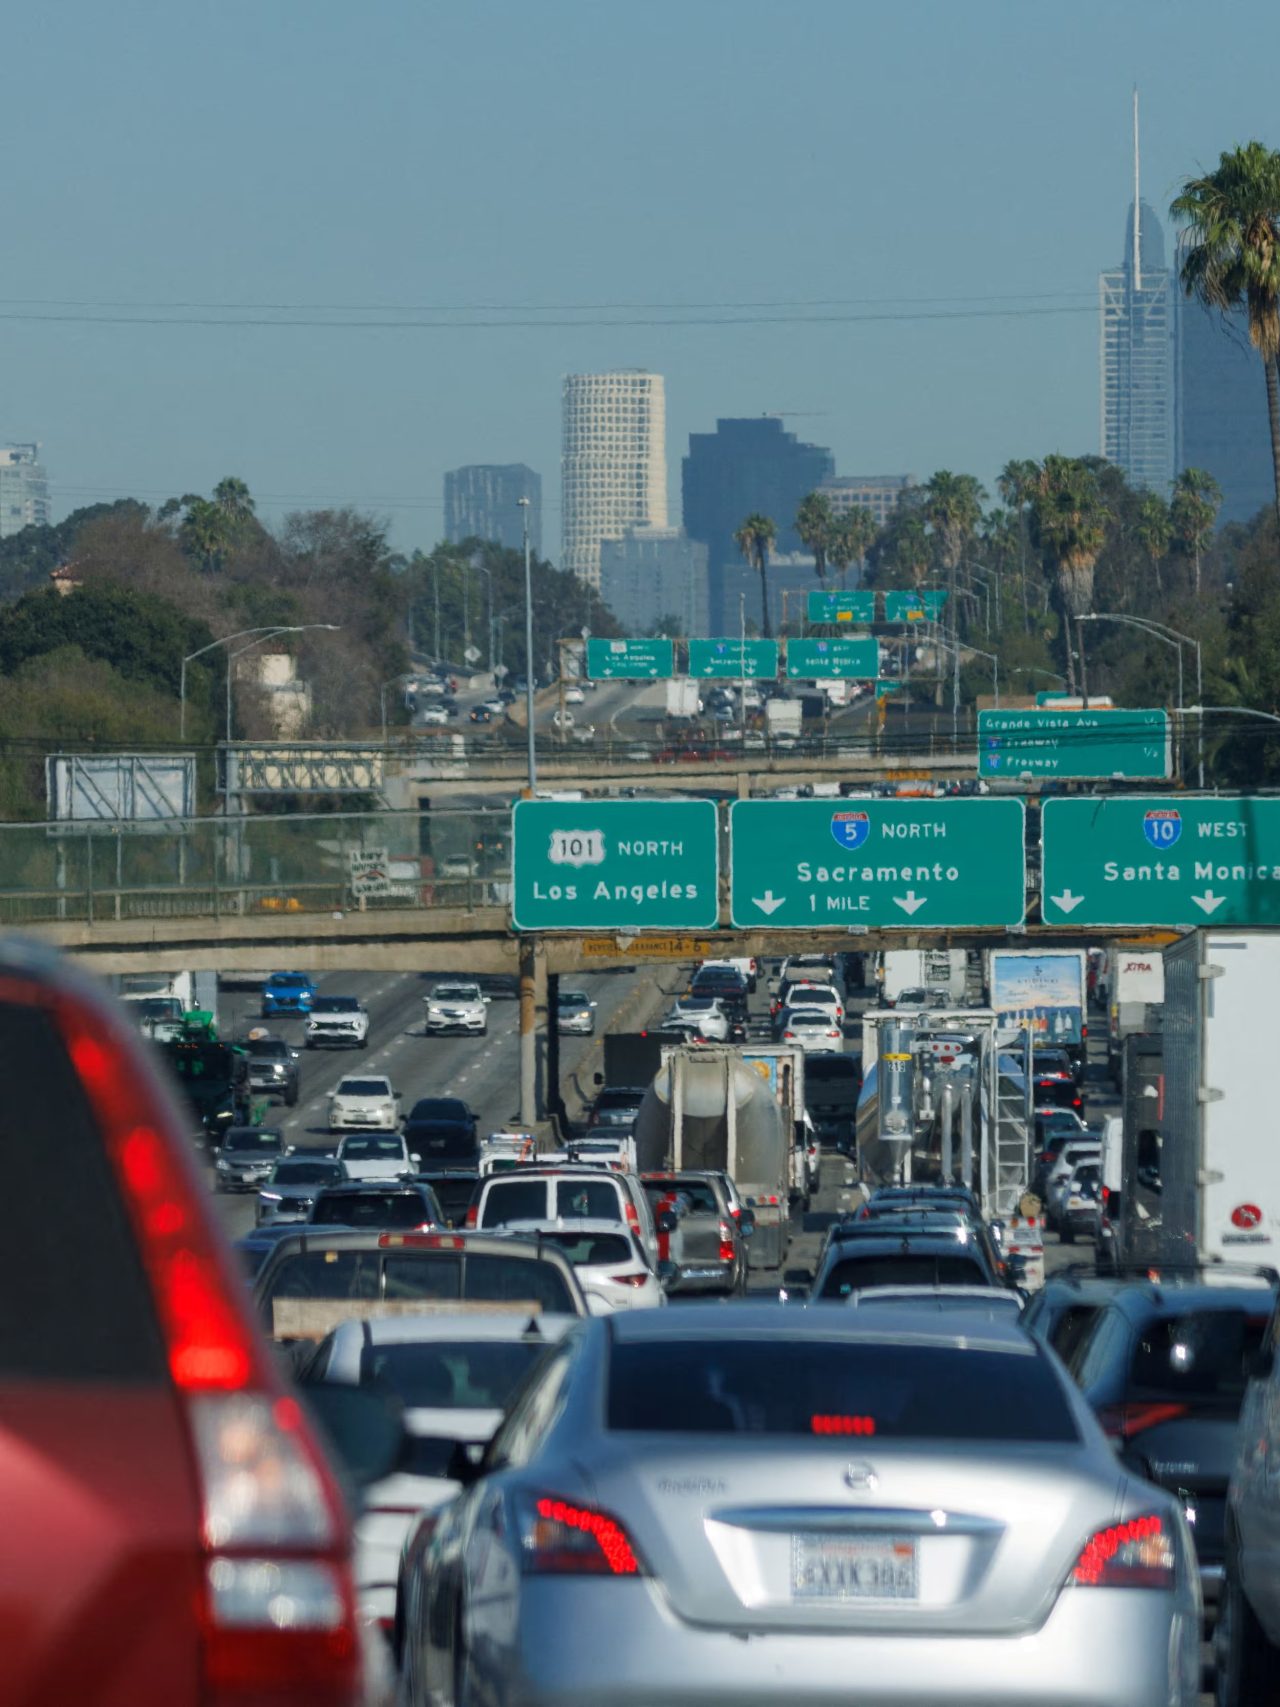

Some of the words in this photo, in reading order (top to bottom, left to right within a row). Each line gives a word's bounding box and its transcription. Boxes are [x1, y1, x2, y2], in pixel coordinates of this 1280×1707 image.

[986, 718, 1031, 729] Grande
[1037, 718, 1069, 728] Vista
[1076, 717, 1099, 727] Ave
[1006, 756, 1059, 769] Freeway
[844, 822, 858, 841] 5
[881, 822, 946, 839] NORTH
[1151, 820, 1175, 841] 10
[1197, 821, 1249, 838] WEST
[561, 838, 593, 857] 101
[617, 840, 683, 856] NORTH
[796, 862, 960, 882] Sacramento
[1103, 861, 1181, 882] Santa
[533, 880, 578, 900] Los
[593, 880, 698, 905] Angeles
[809, 893, 816, 912] 1
[827, 895, 871, 911] MILE
[1123, 961, 1153, 974] XTRA
